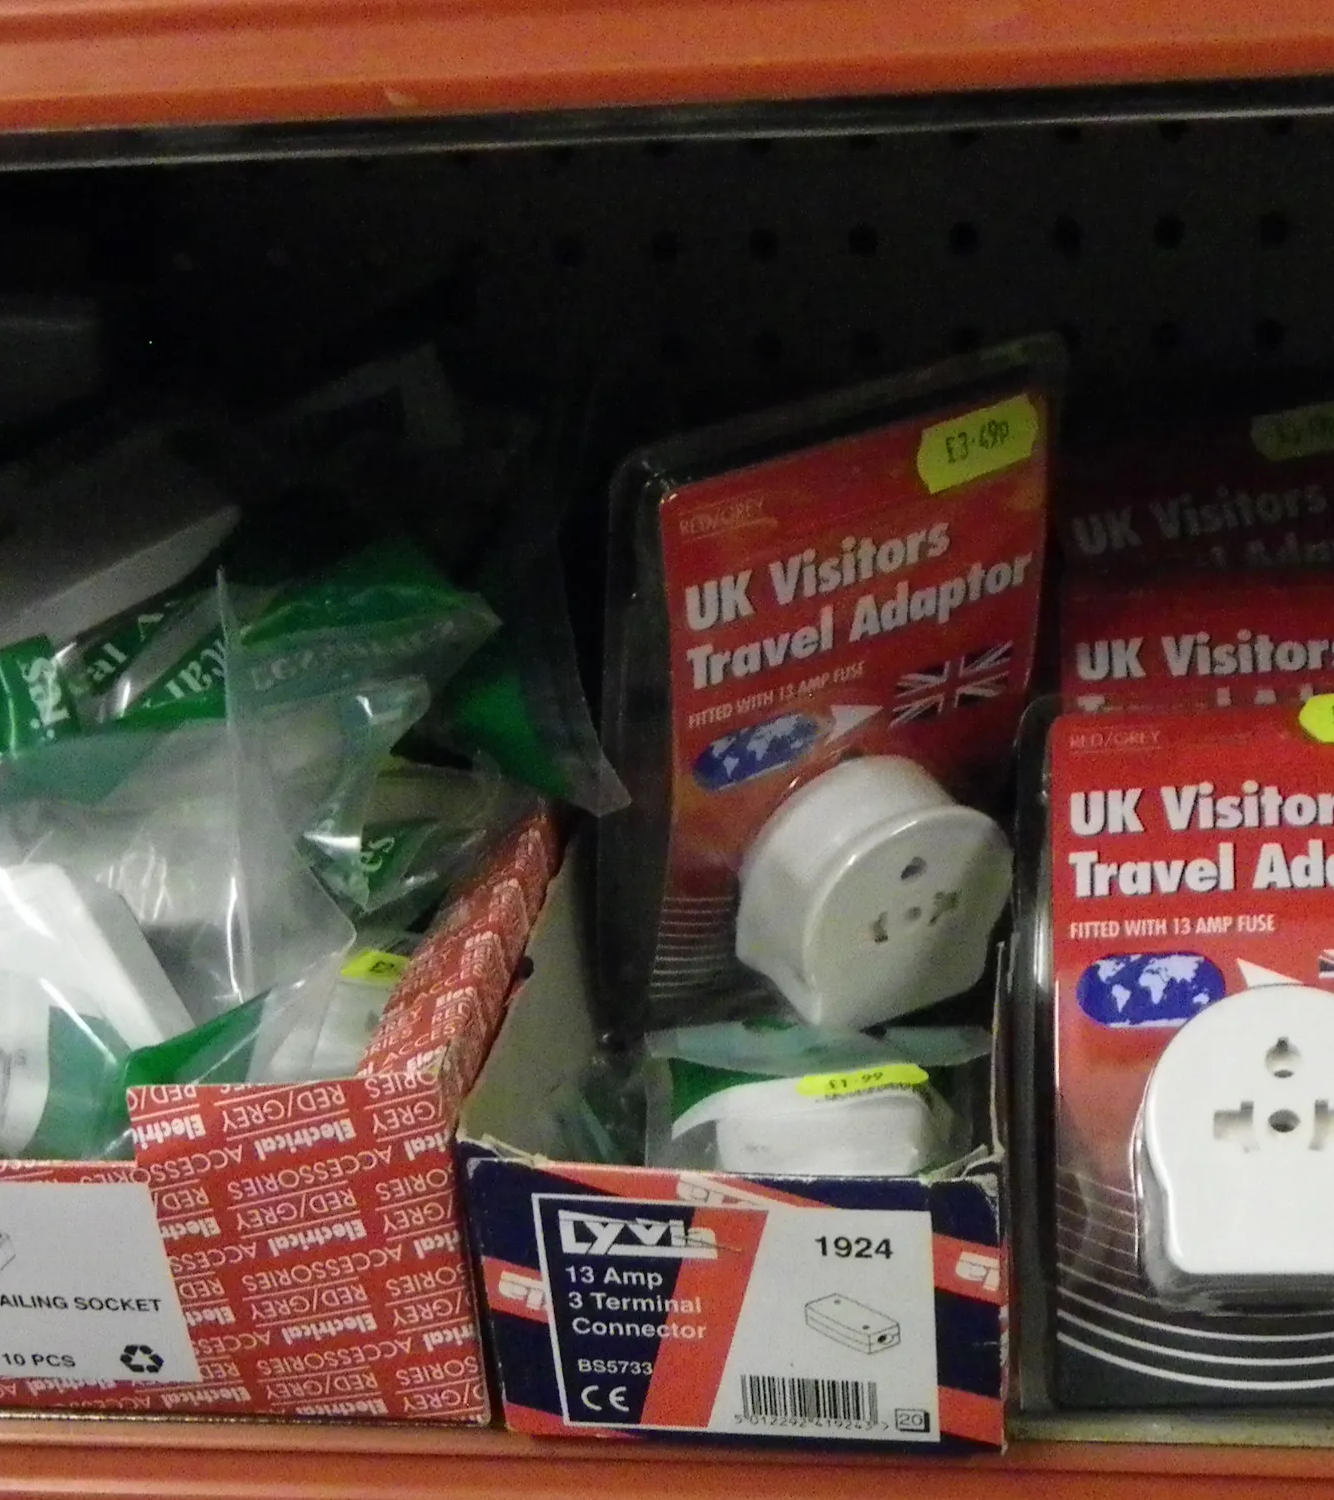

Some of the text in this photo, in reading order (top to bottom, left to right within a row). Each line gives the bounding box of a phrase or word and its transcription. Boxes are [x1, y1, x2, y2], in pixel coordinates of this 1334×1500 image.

[1073, 484, 1327, 557] UK Visitors
[685, 521, 951, 631] UK Visitors
[685, 551, 1033, 692] Travel Adaptor
[1076, 634, 1147, 682] UK
[1068, 788, 1146, 838] UK
[1067, 842, 1235, 899] Travel
[1069, 913, 1276, 941] FITTED WITH 13 AMP FUSE
[815, 1236, 895, 1261] 1924
[564, 1266, 664, 1291] 13 Amp
[73, 1296, 162, 1313] SOCKET
[567, 1292, 703, 1315] 3 Terminal
[571, 1317, 708, 1342] Connector
[1, 1351, 77, 1369] 10 PCS
[577, 1358, 655, 1376] BS5733
[897, 1411, 924, 1427] 20
